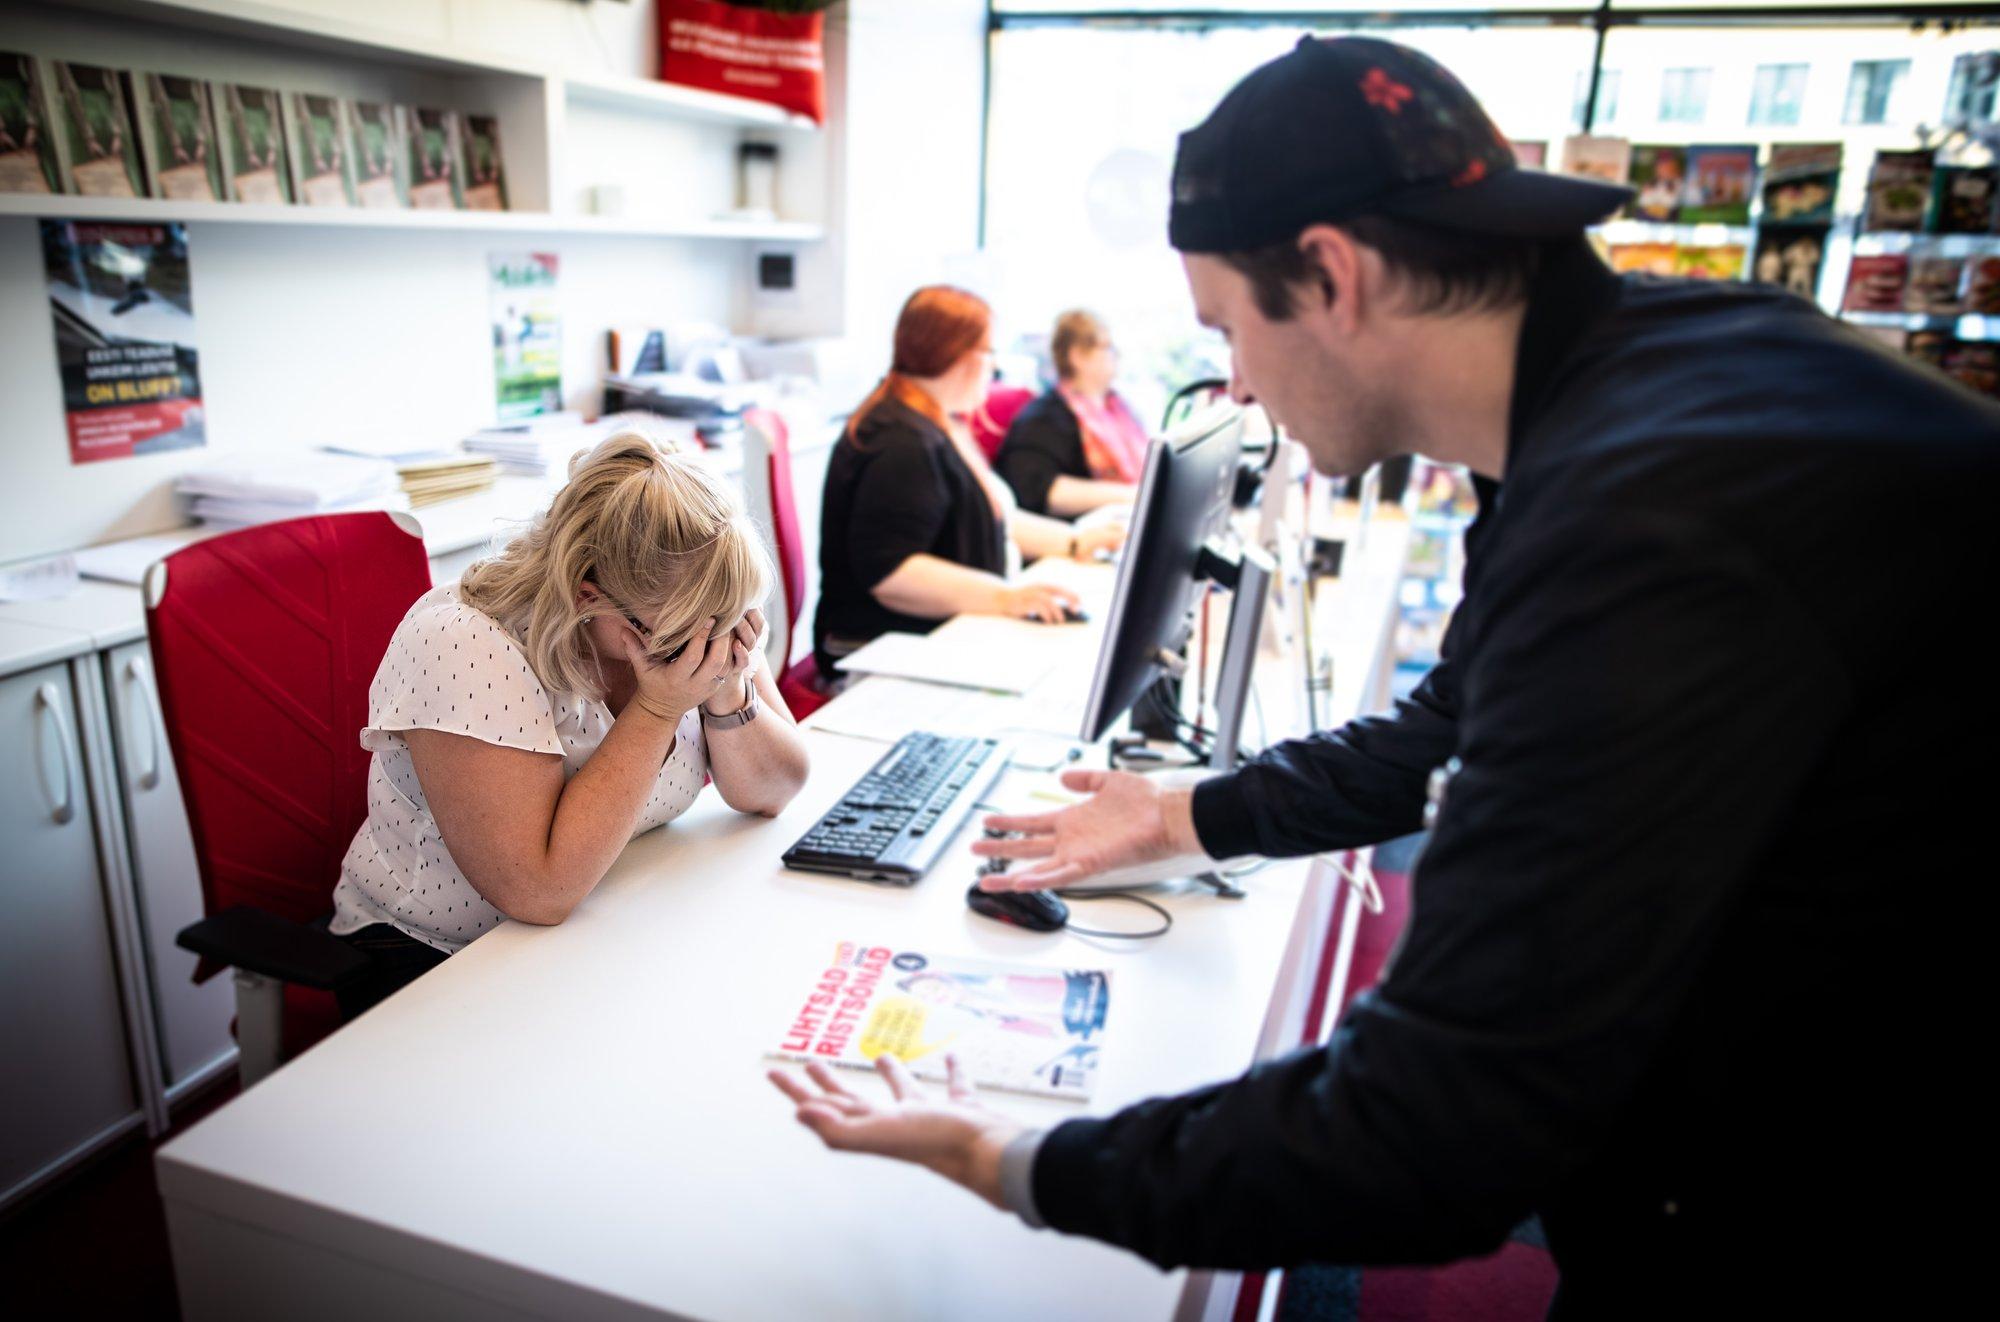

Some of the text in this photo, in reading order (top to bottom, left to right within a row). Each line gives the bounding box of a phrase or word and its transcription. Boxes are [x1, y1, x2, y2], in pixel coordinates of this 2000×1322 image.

[86, 383, 115, 404] ON
[780, 968, 848, 1052] LIHTSAD
[814, 947, 892, 1057] RISTSÕNAD
